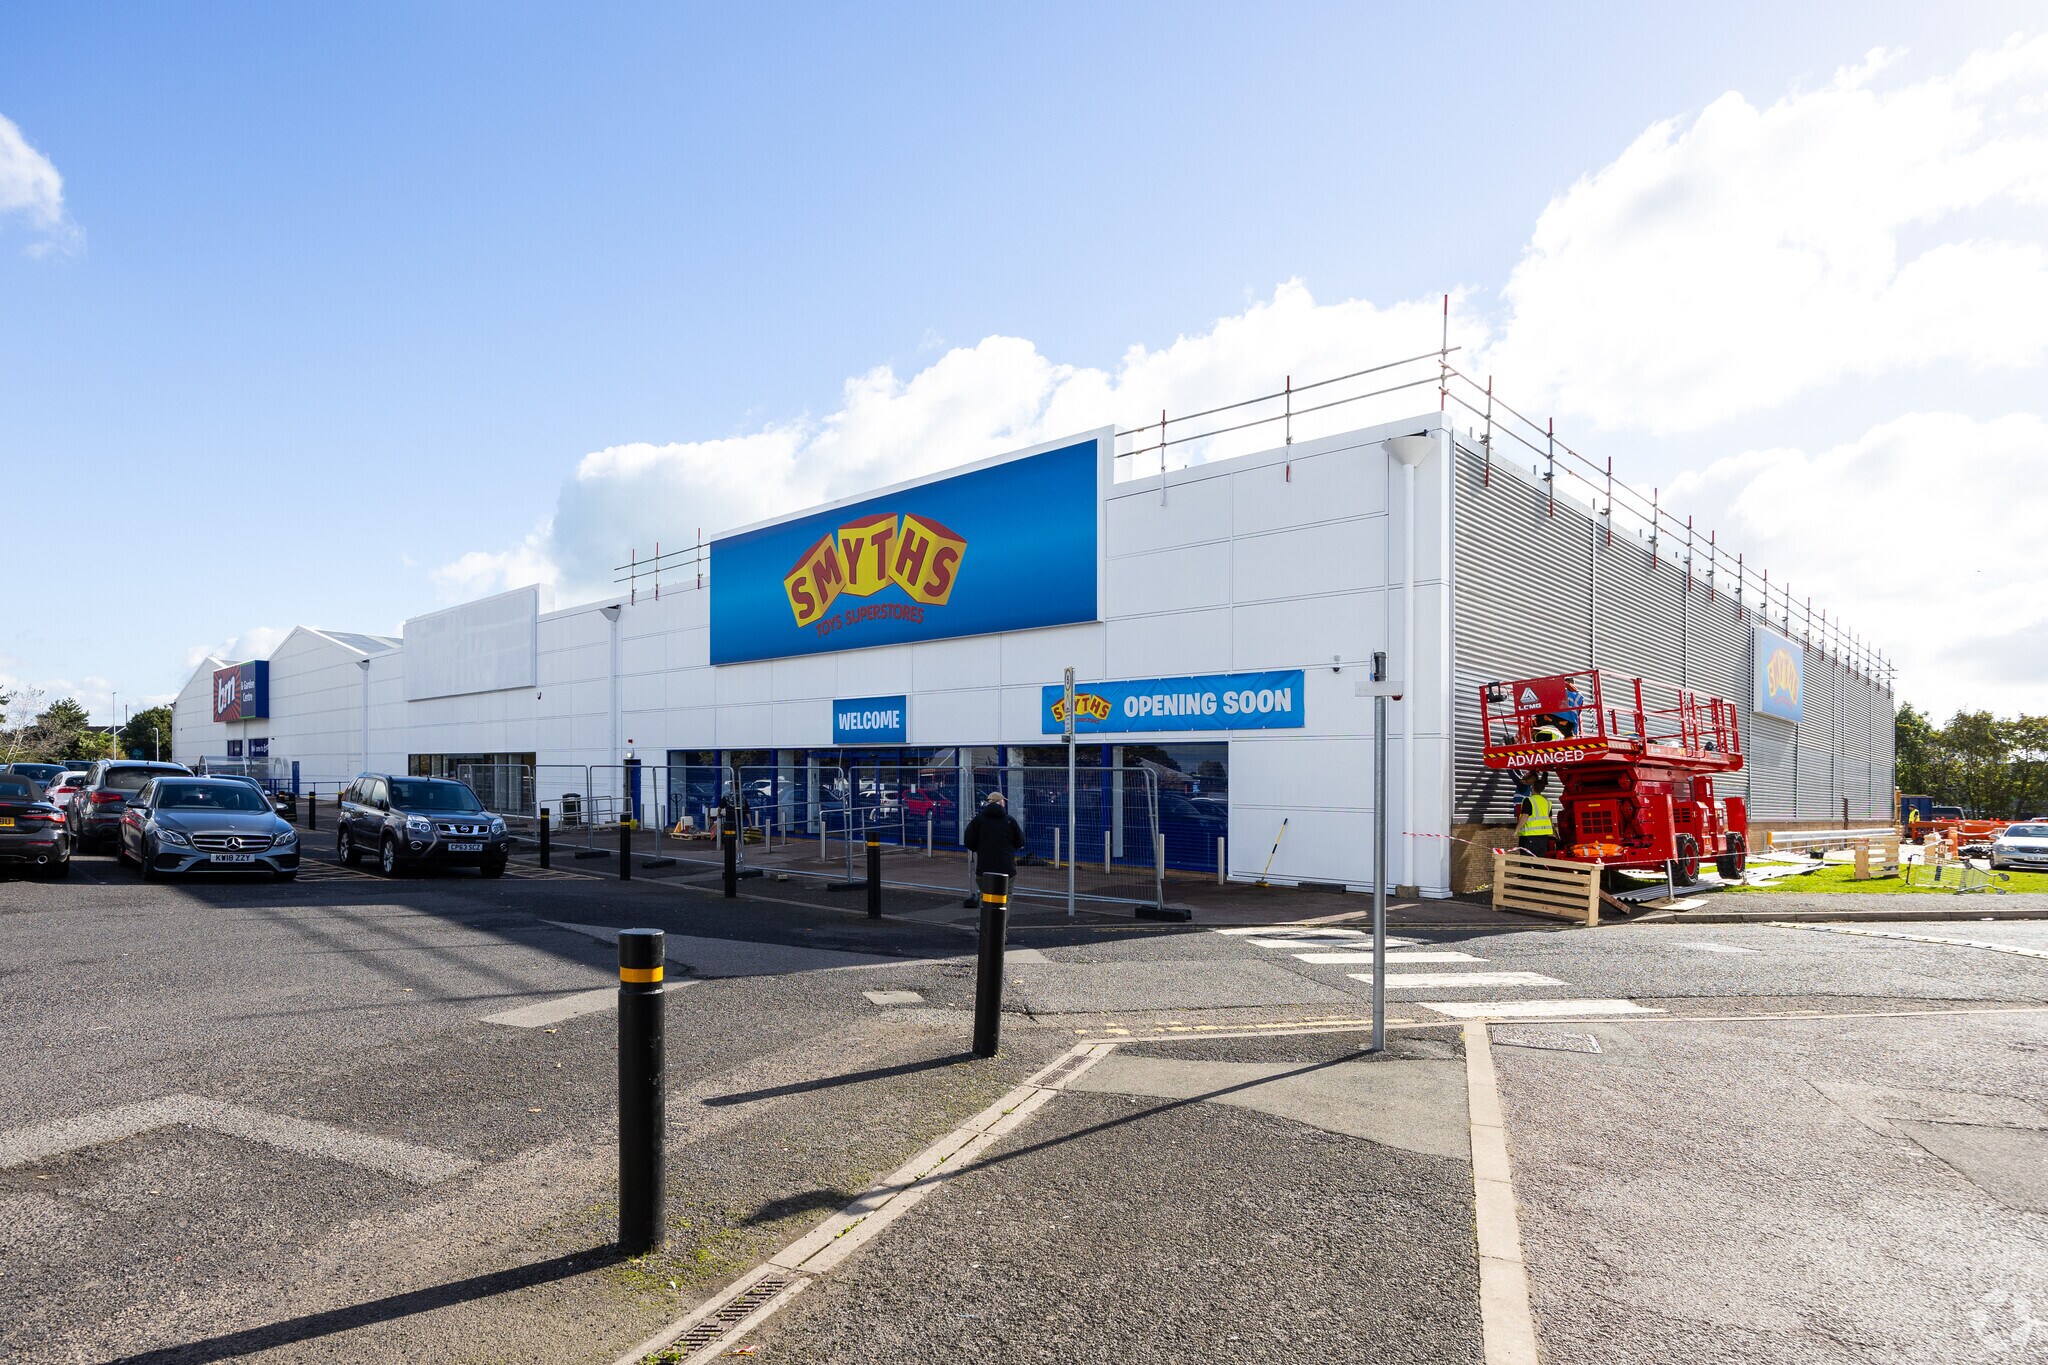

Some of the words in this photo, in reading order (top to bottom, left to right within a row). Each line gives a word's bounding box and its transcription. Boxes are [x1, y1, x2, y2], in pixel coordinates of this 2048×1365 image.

[791, 527, 959, 620] SMYTHS
[816, 615, 842, 638] TOYS
[845, 603, 925, 625] SUPERSTORES
[244, 680, 255, 690] Garden
[242, 692, 254, 703] Centre
[1123, 692, 1218, 717] OPENING
[1222, 688, 1292, 715] SOON
[1053, 697, 1110, 720] SYTHS
[838, 710, 900, 731] WELCOME
[1507, 750, 1585, 767] ADVANCED
[215, 854, 234, 862] KW18
[235, 854, 251, 862] ZZY
